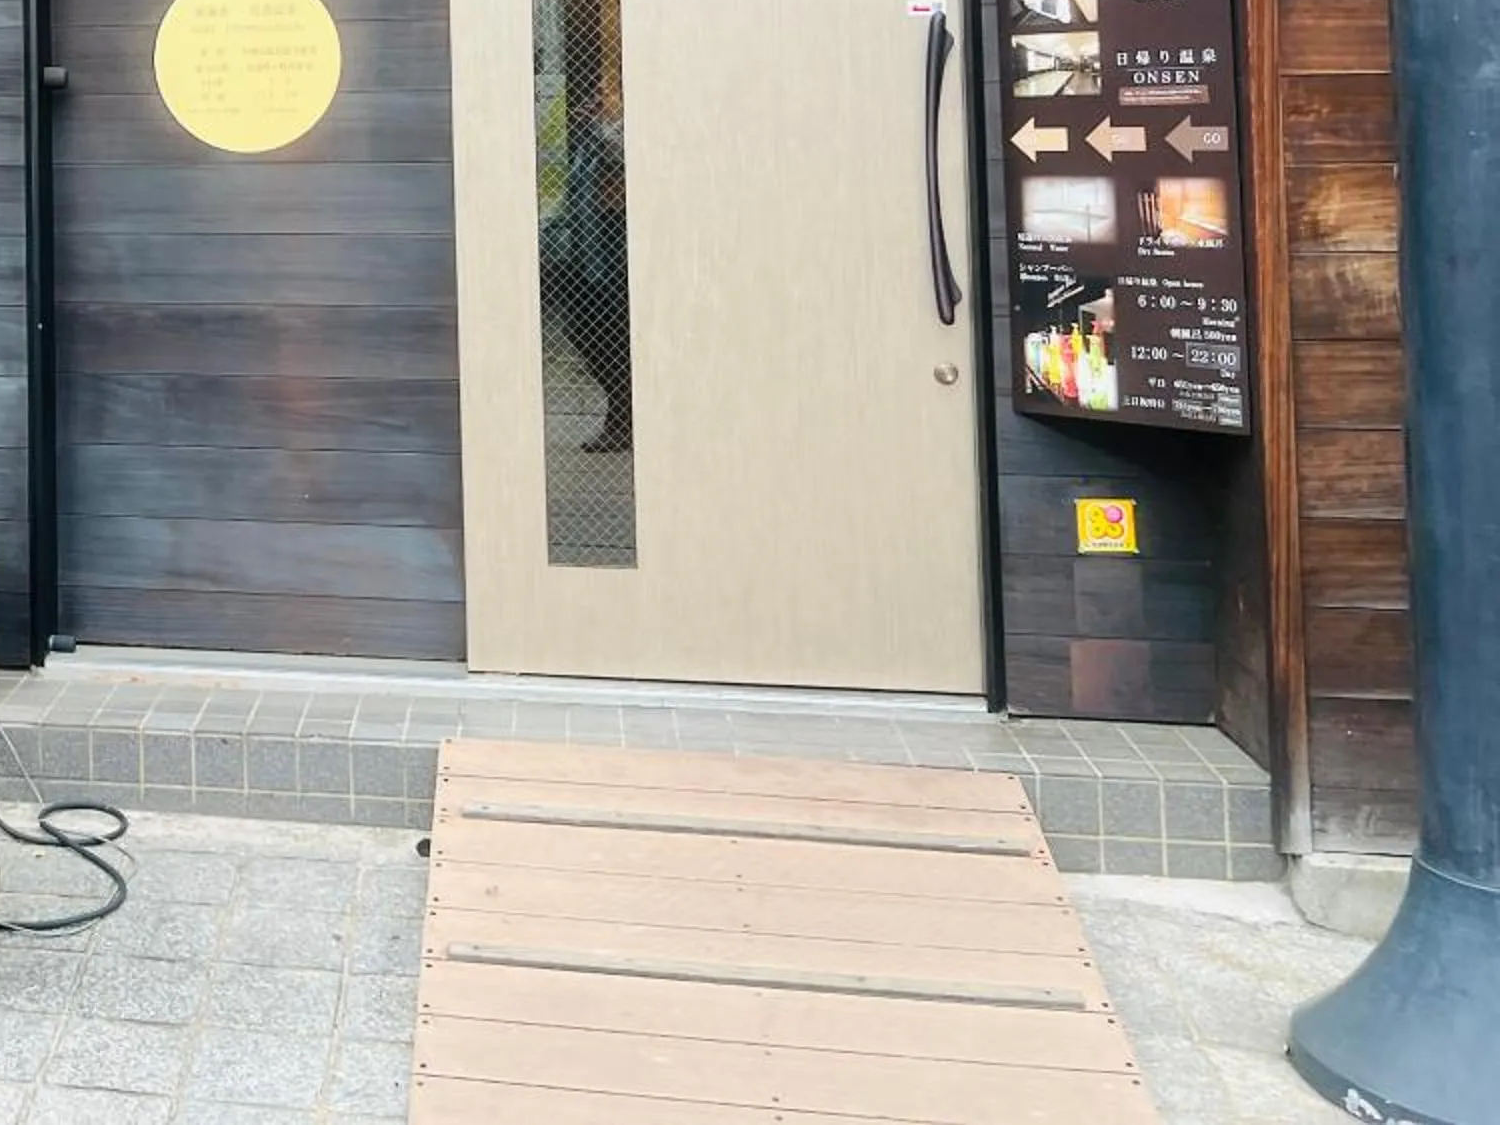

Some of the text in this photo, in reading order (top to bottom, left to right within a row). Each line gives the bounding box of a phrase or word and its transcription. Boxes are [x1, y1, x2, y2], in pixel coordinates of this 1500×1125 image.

[1117, 47, 1217, 66] 日帰り温泉
[1133, 70, 1200, 84] ONSEN
